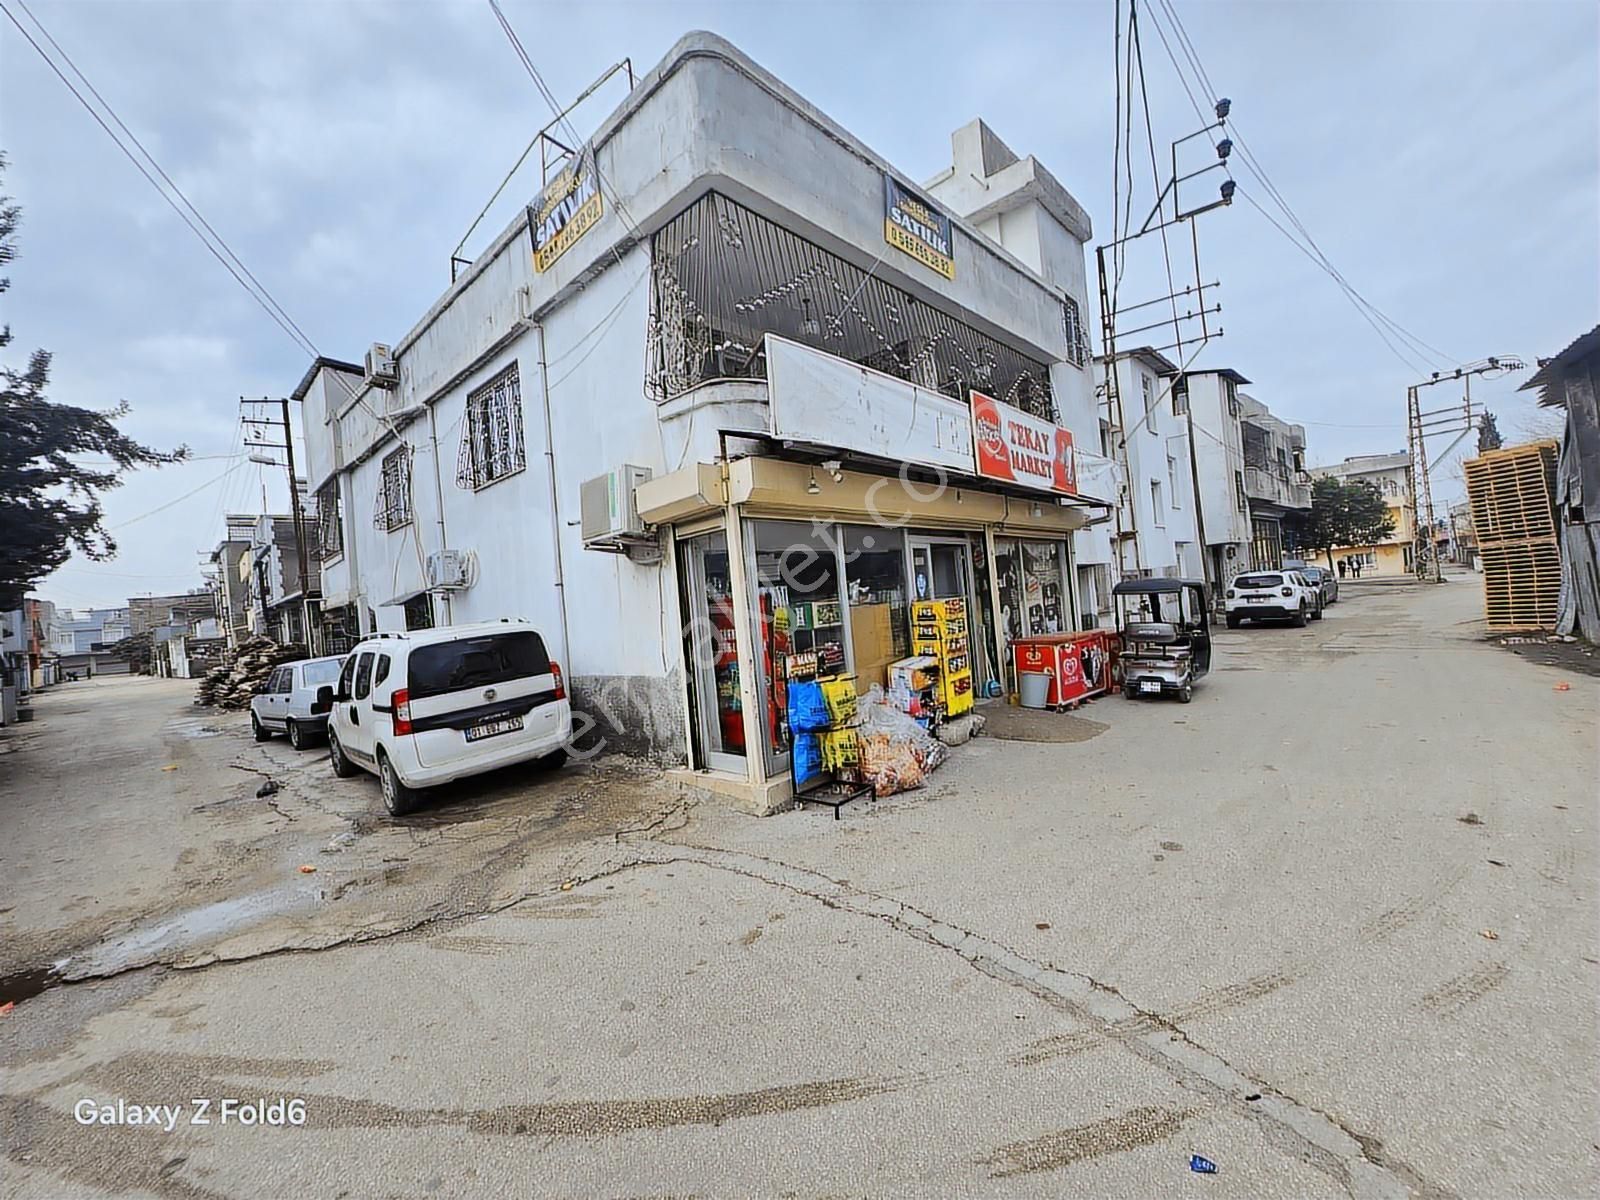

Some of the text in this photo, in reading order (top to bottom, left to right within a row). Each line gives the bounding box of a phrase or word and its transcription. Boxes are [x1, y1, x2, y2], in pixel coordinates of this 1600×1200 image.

[537, 174, 595, 250] SATILIK
[890, 207, 948, 255] SATILIK
[1008, 420, 1050, 455] TEKAY
[1011, 450, 1053, 479] MARKET
